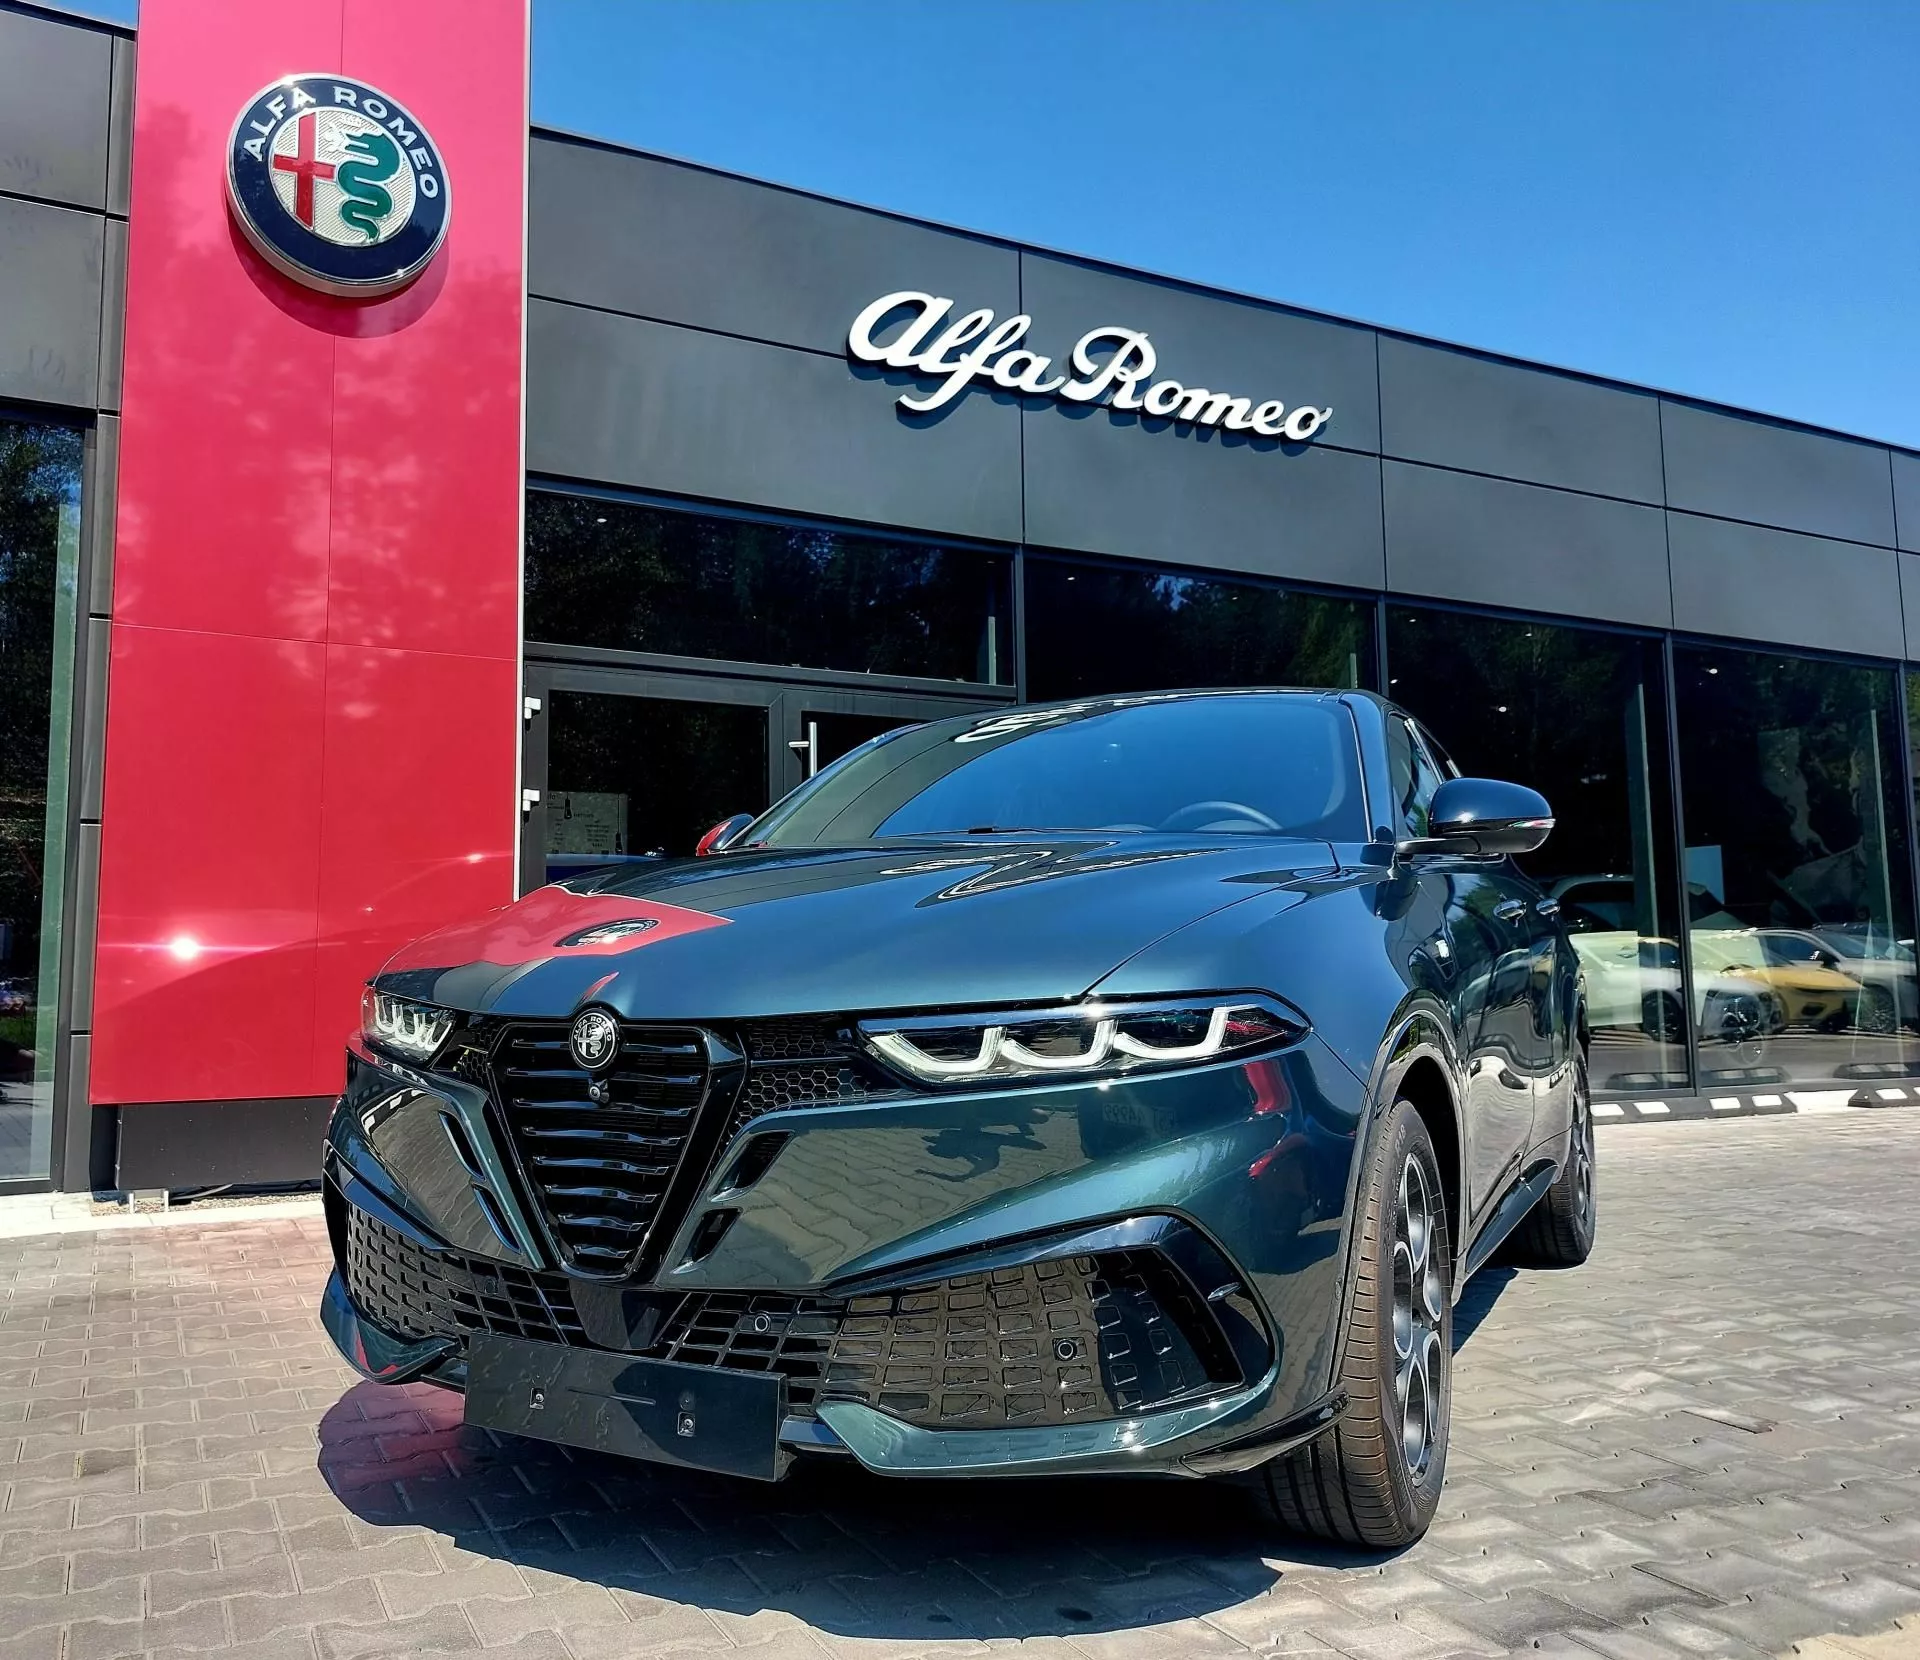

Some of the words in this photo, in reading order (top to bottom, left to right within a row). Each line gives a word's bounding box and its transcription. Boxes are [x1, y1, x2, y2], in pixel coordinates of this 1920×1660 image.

[243, 86, 316, 162] ALFA
[333, 86, 439, 199] ROMEO
[848, 290, 1066, 411] Alfa
[1060, 326, 1333, 441] Romeo
